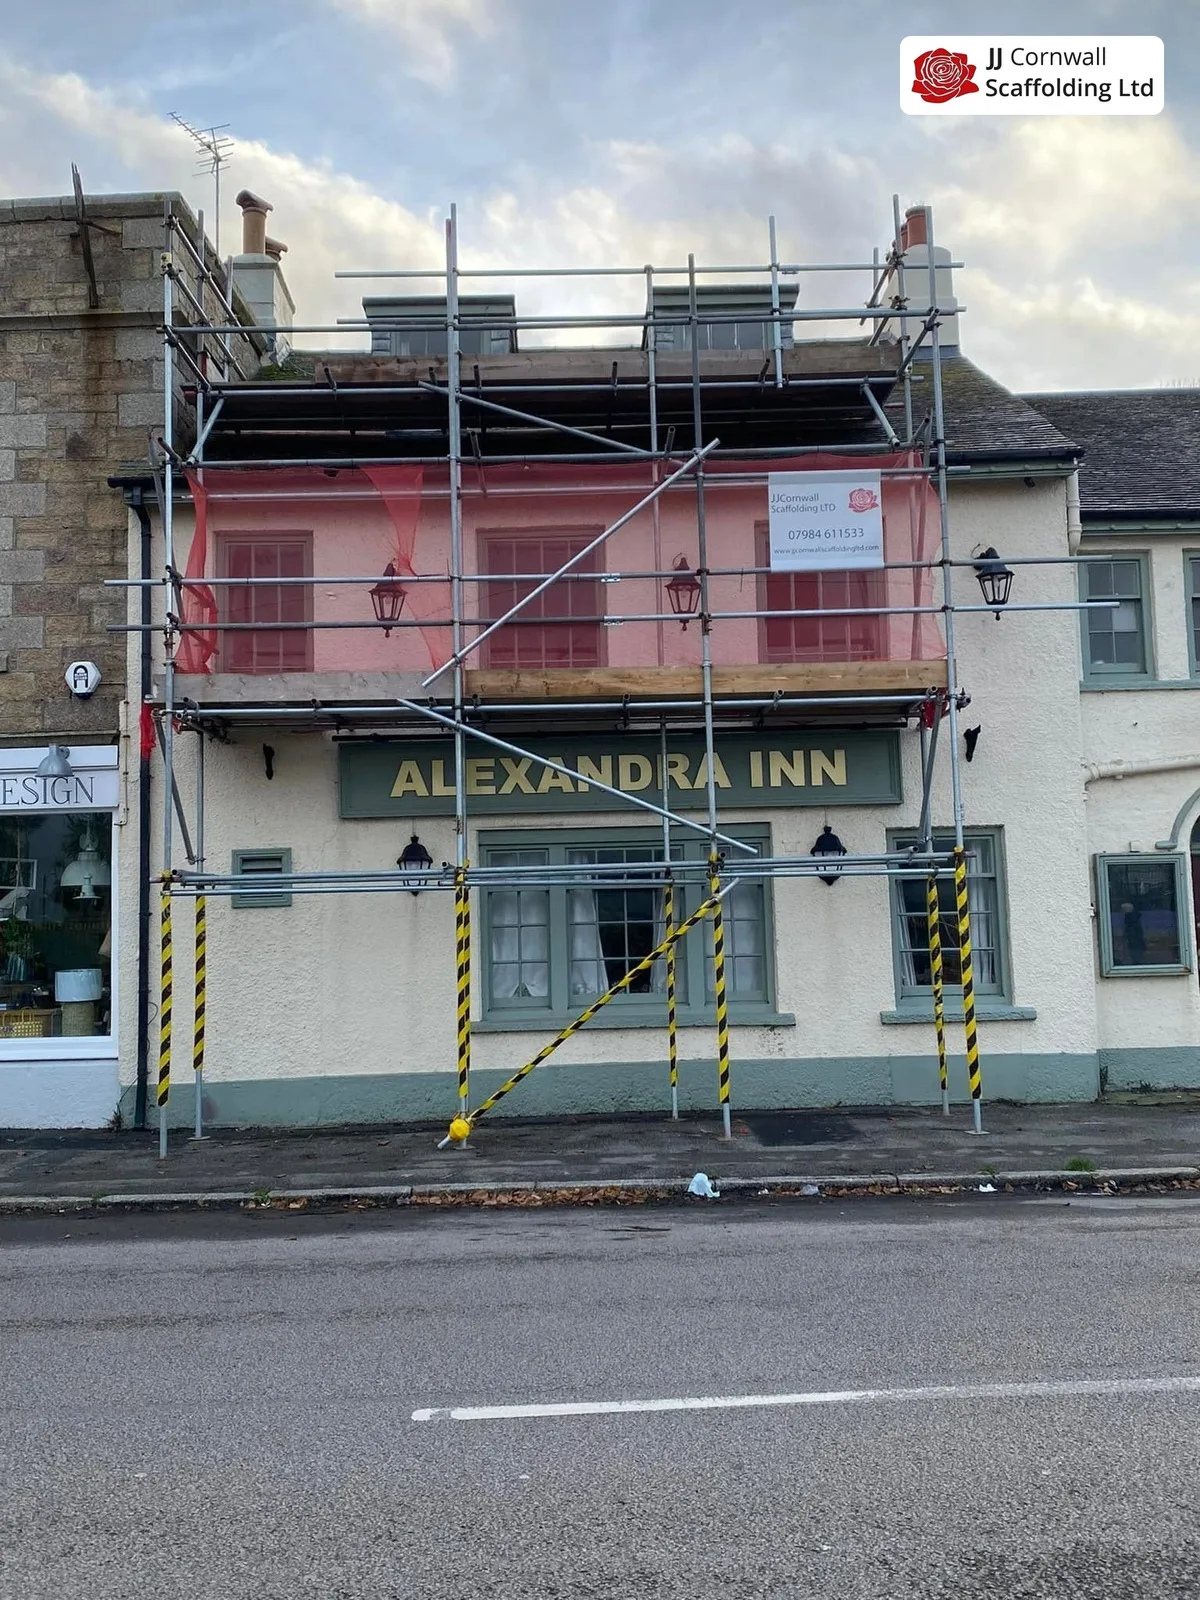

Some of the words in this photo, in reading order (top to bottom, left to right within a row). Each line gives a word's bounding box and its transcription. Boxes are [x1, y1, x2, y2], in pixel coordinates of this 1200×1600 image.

[771, 503, 818, 514] Scaffolding
[820, 503, 836, 512] LTD
[788, 529, 821, 540] 07984
[824, 528, 864, 538] 611533
[390, 753, 732, 797] ALEXANDRA
[750, 750, 847, 787] INN
